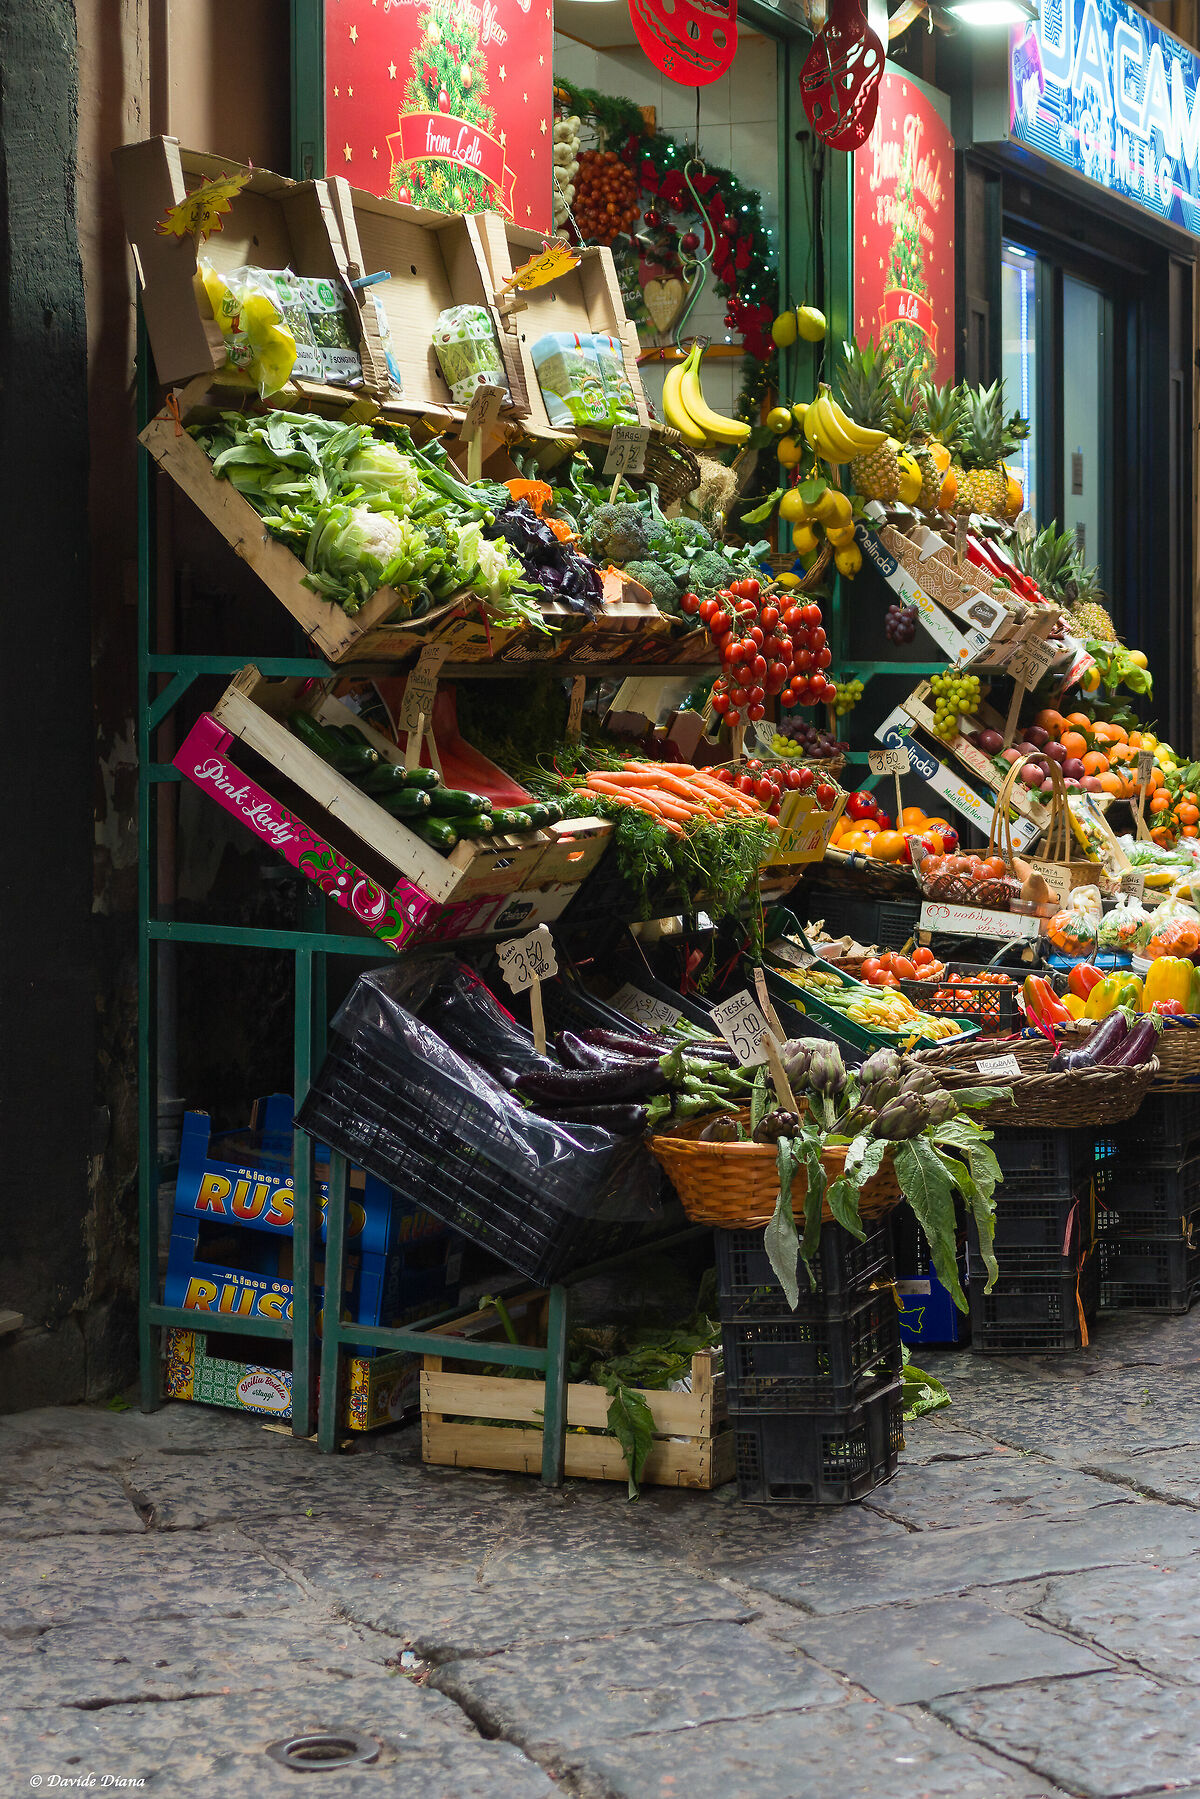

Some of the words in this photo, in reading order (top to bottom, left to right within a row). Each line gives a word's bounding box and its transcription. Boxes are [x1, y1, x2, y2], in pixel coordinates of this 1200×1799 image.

[482, 0, 507, 46] Year
[426, 118, 450, 154] from
[452, 125, 482, 166] Lello
[1078, 109, 1173, 207] GAMING
[333, 355, 357, 364] SONGINO
[854, 523, 893, 576] Melinda
[912, 588, 936, 613] DOP
[887, 731, 934, 778] Mlinda
[193, 758, 252, 805] Pink
[241, 799, 294, 845] Lady
[957, 786, 982, 809] DOP
[1032, 863, 1058, 876] BATATA
[501, 945, 516, 961] EURO
[514, 940, 543, 983] 3,50
[713, 1006, 724, 1024] 5
[722, 996, 749, 1018] TESTE
[240, 1375, 264, 1394] Sicilia
